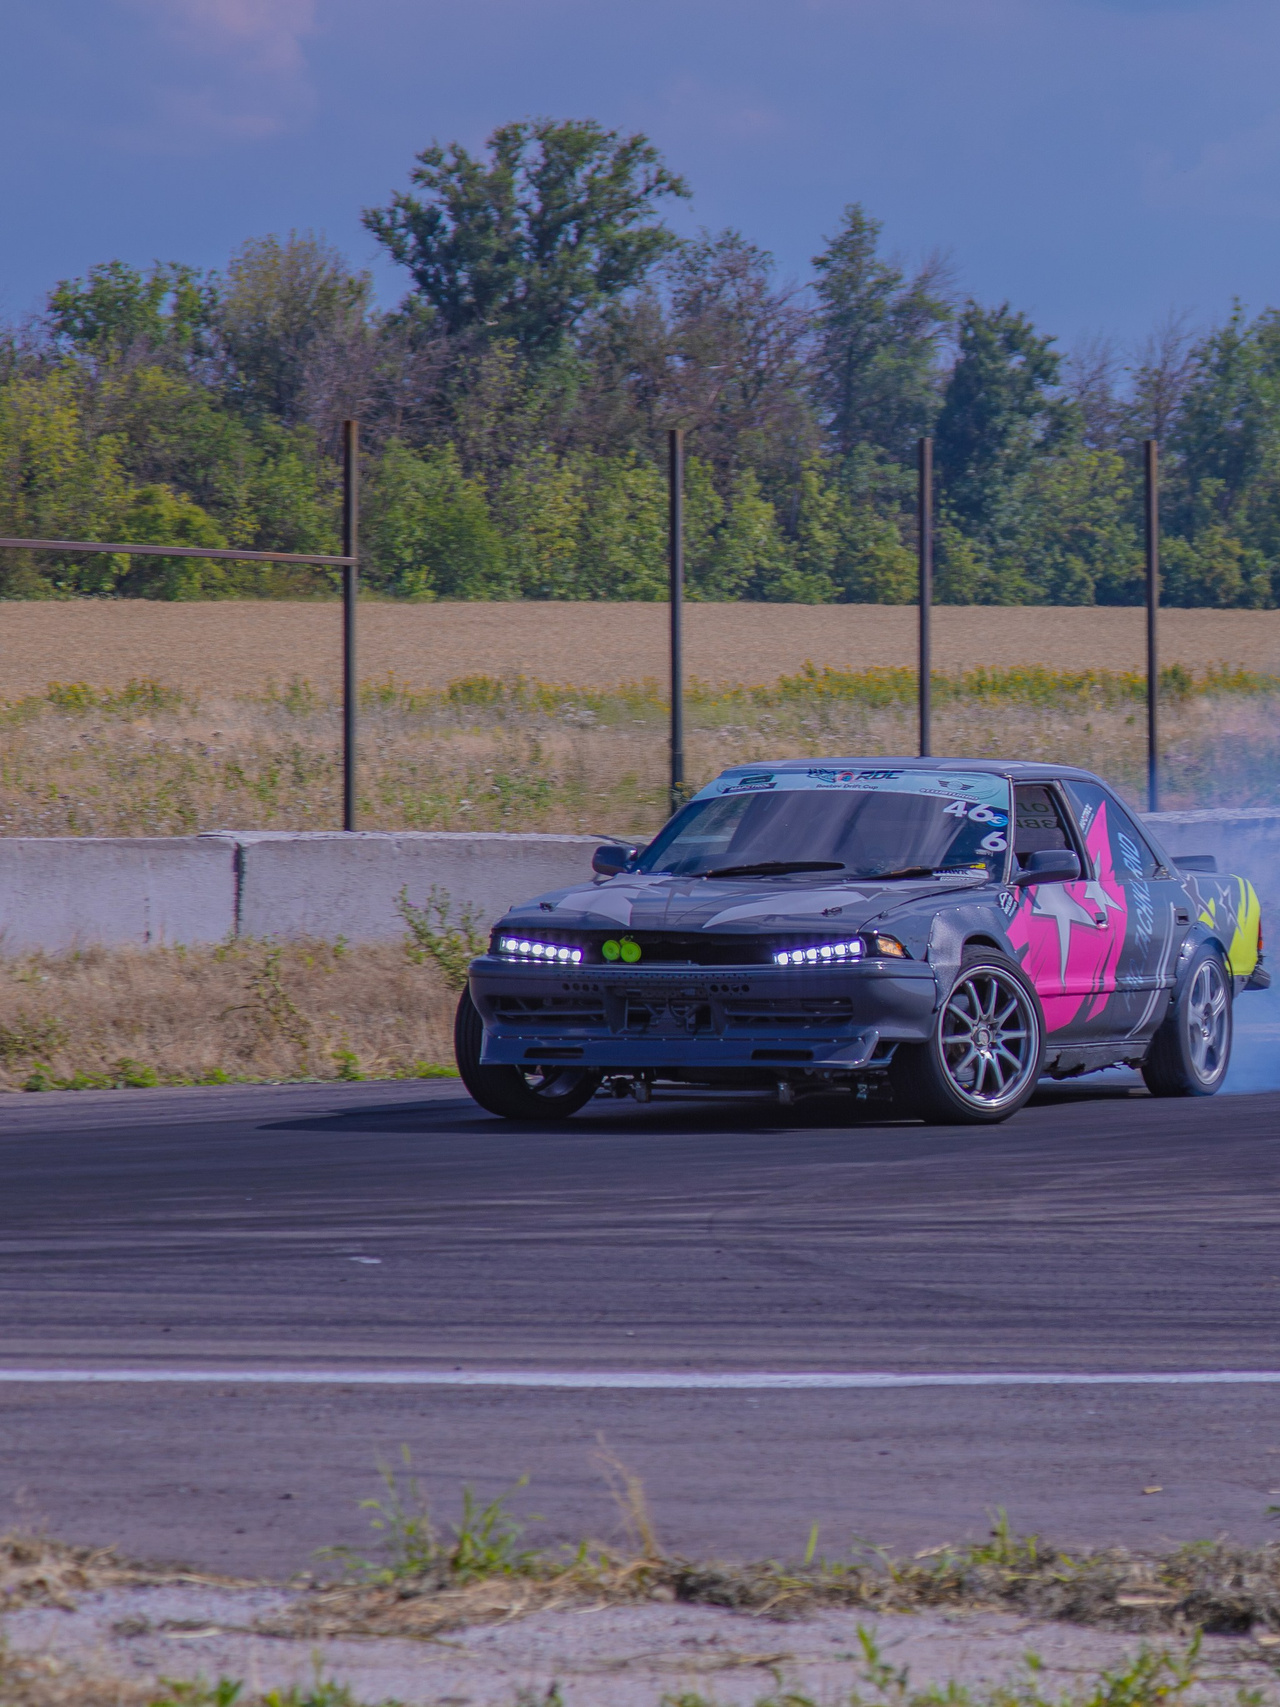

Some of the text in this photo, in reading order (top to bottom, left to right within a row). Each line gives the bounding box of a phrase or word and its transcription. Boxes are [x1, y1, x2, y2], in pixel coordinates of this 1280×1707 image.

[856, 770, 904, 780] RDC
[943, 800, 994, 822] 46
[981, 831, 1008, 852] 6
